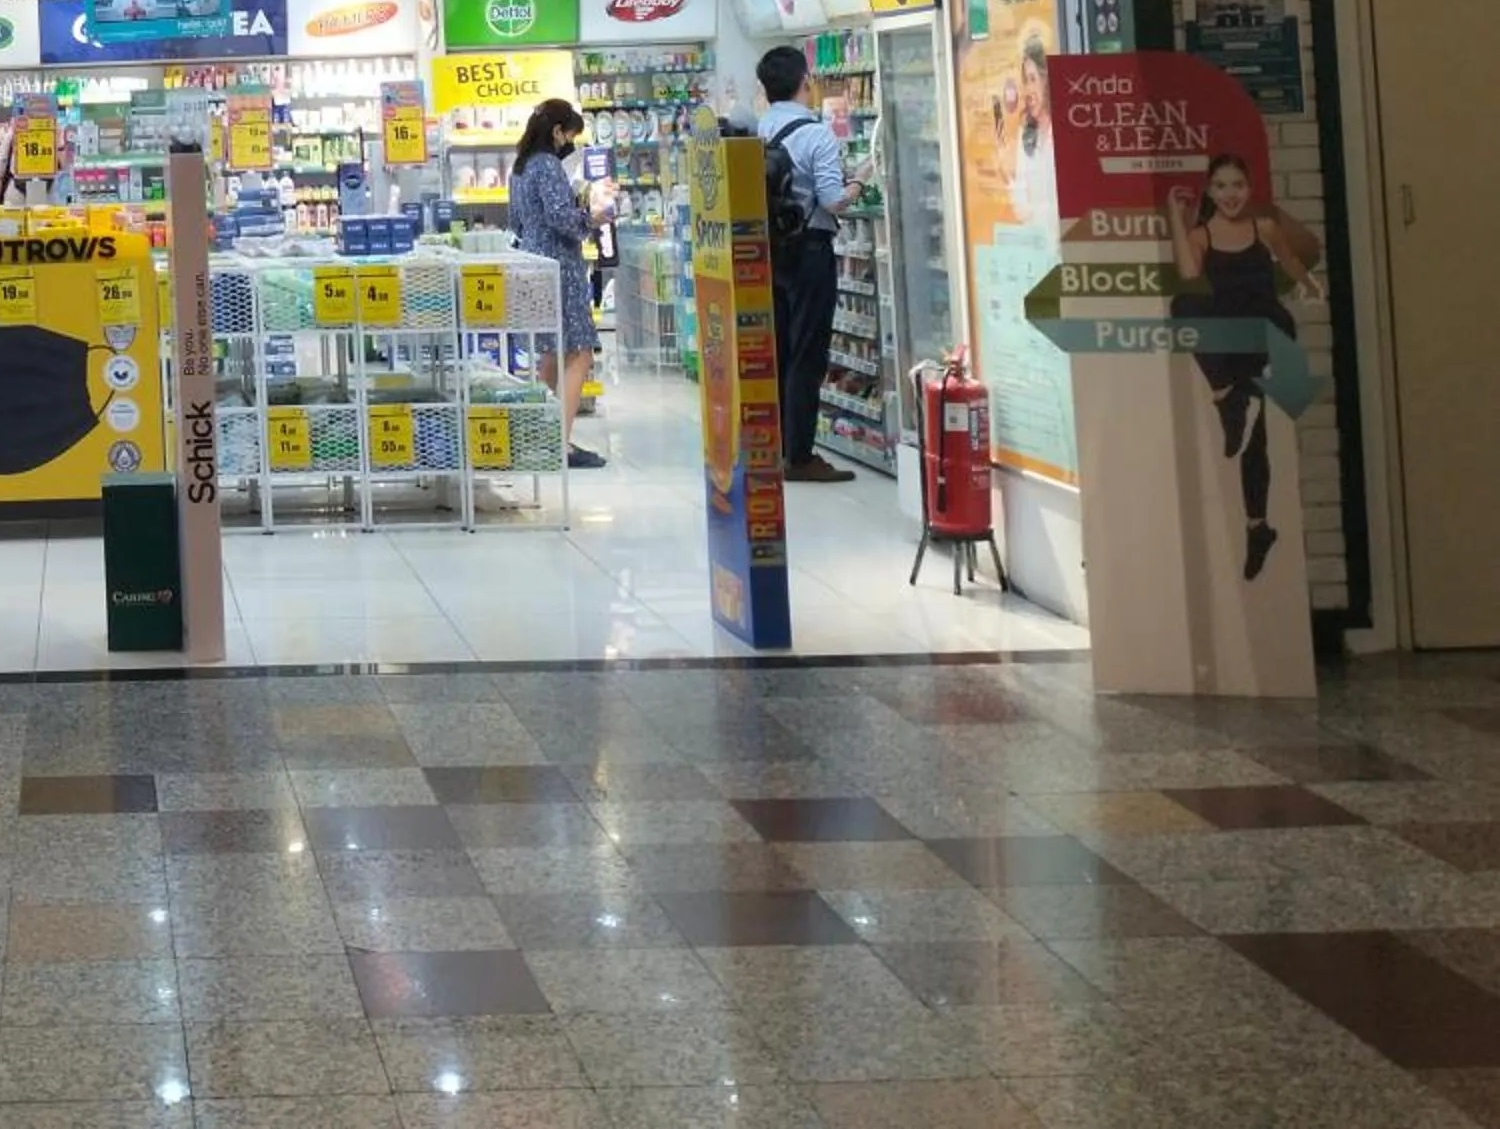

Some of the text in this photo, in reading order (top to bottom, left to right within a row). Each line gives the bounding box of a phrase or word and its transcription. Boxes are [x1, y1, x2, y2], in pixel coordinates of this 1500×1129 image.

[490, 5, 533, 20] Dettol
[456, 62, 507, 84] BEST
[1067, 100, 1189, 129] CLEAN
[1091, 210, 1170, 237] Burn
[1060, 265, 1162, 292] Block
[1095, 322, 1199, 351] Purge
[183, 328, 196, 376] Be you.
[734, 219, 782, 564] PROTECT THE FUN
[188, 400, 214, 504] Schick
